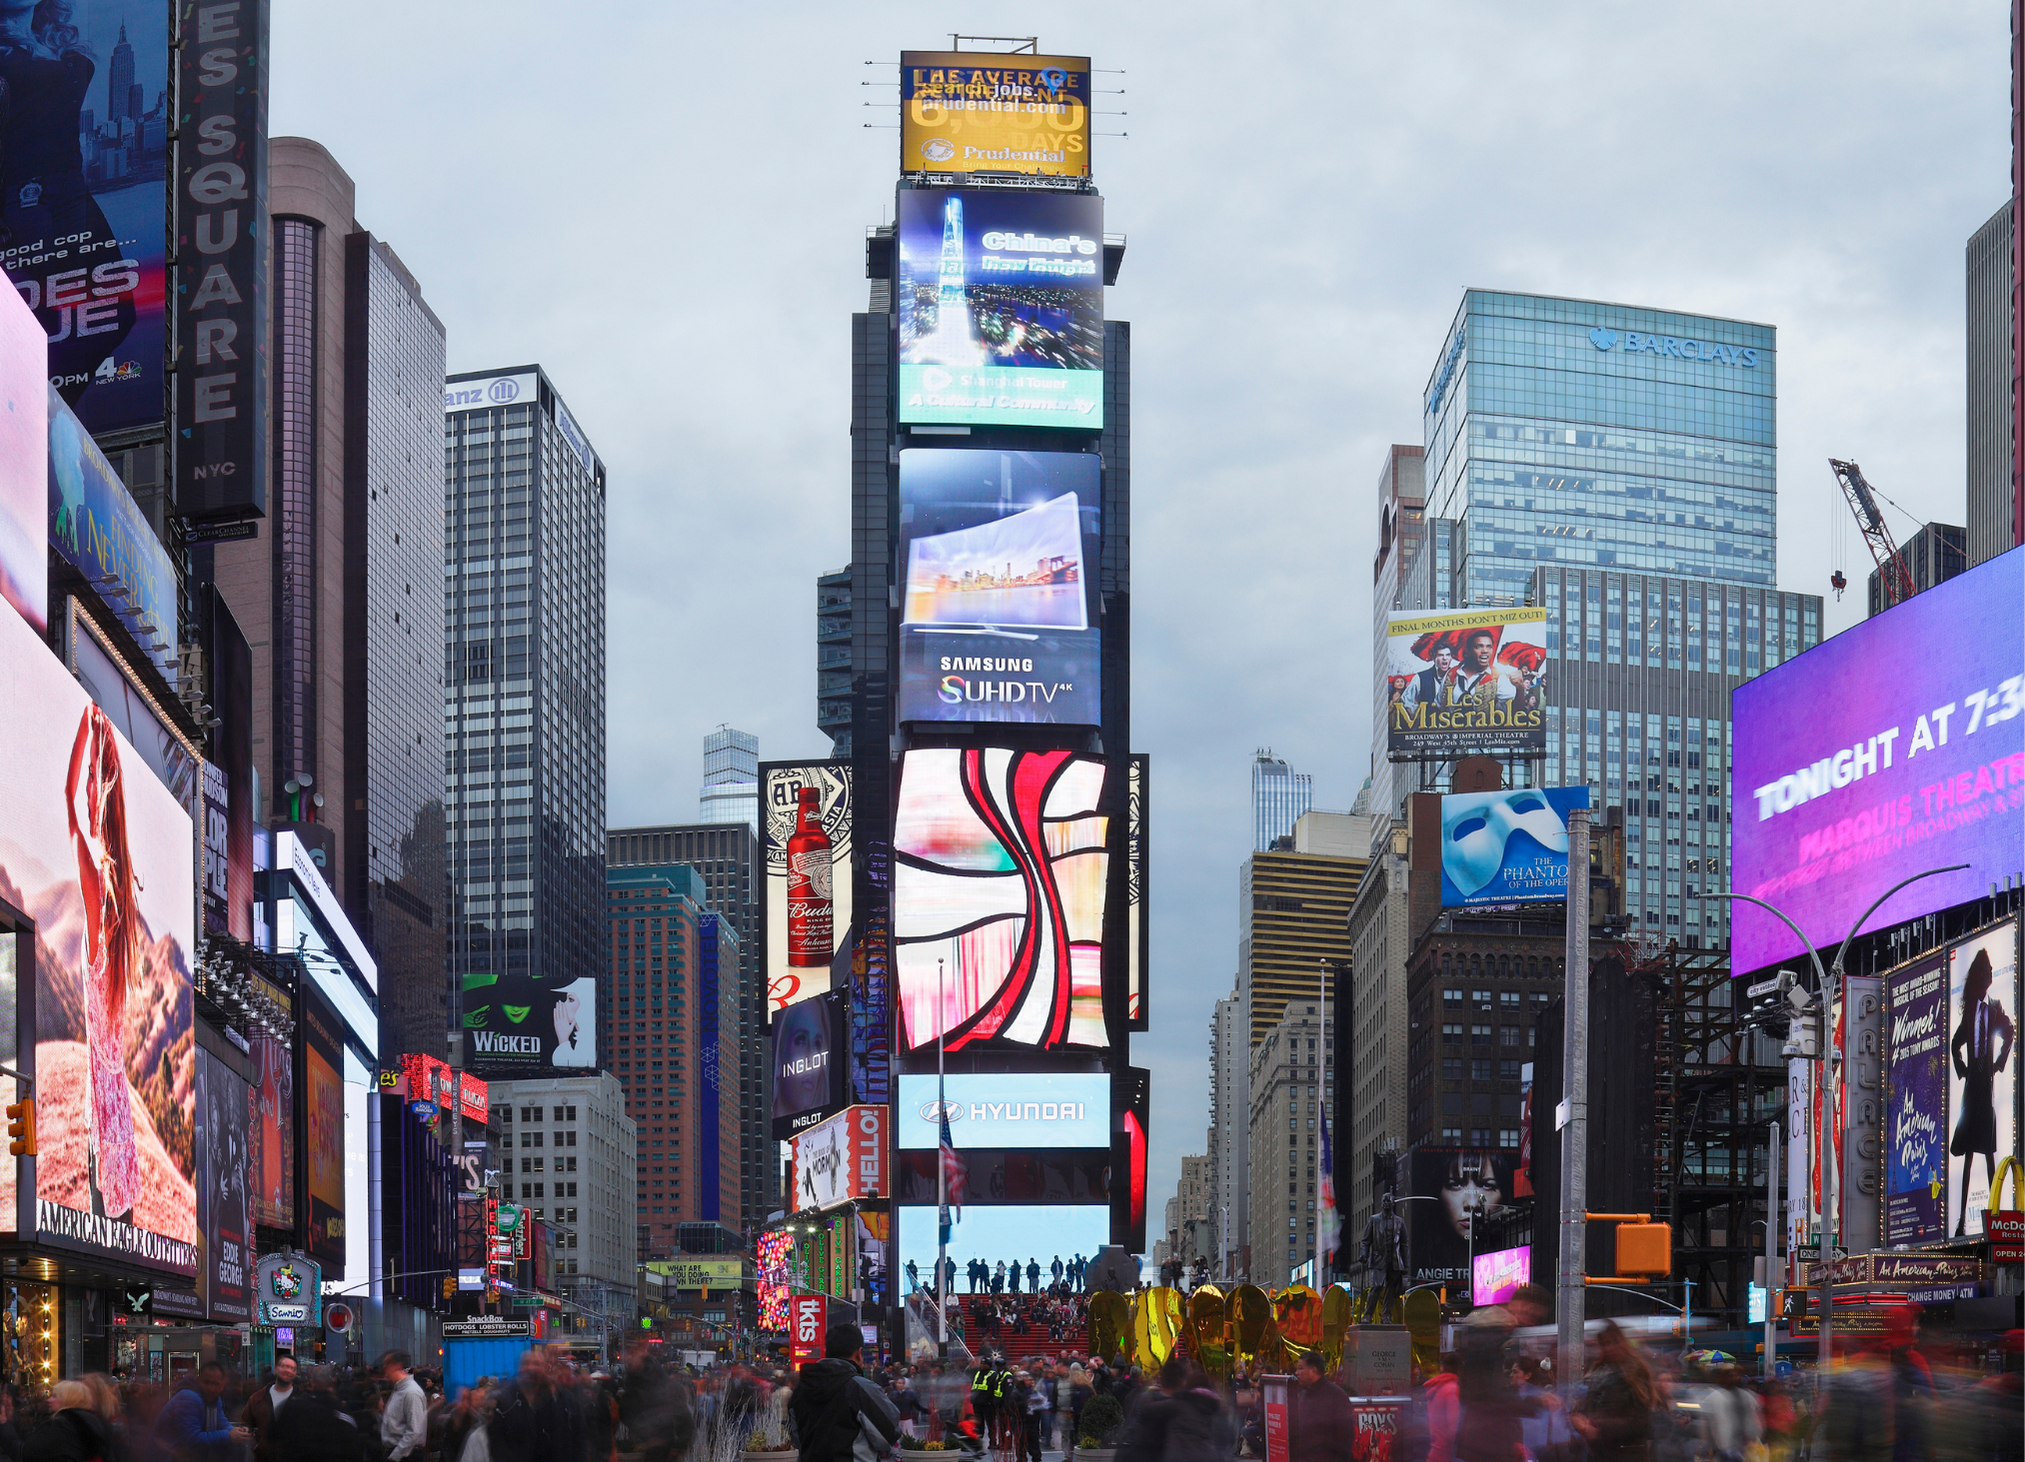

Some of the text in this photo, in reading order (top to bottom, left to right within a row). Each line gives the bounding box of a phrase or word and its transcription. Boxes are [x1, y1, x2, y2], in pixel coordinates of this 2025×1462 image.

[923, 81, 1038, 98] search jobs.
[922, 98, 1066, 115] prudential.com
[1014, 132, 1083, 153] DAYS
[963, 146, 1066, 163] Prudential
[962, 162, 989, 171] Bring
[991, 162, 1014, 171] Your
[0, 231, 92, 263] good cop
[982, 231, 1098, 256] China's
[5, 238, 137, 271] there are...
[188, 114, 248, 425] SQUARE
[1624, 331, 1758, 368] BARCLAYS
[96, 356, 117, 378] 4
[96, 373, 142, 386] NEW YORK
[1026, 376, 1069, 390] Tower
[907, 394, 1096, 415] A Cultural Community
[194, 462, 236, 481] NYC
[112, 514, 159, 605] FINDING
[1392, 623, 1420, 633] FINAL
[1467, 615, 1498, 626] DON'T
[1500, 612, 1518, 622] MIZ
[1518, 610, 1543, 621] OUT!
[940, 656, 1034, 673] SAMSUNG
[1059, 683, 1073, 691] 4K
[1446, 685, 1483, 708] Les
[1393, 698, 1542, 730] Misérables
[1404, 731, 1529, 741] BROADWAY'S IMPERIAL THEATRE
[1427, 738, 1442, 746] West
[1459, 737, 1477, 746] Street
[1753, 725, 1899, 822] TONIGHT
[1907, 702, 1956, 760] AT
[1534, 857, 1553, 866] THE
[1509, 878, 1544, 889] OF THE
[701, 927, 718, 1033] NOVOTEL
[1760, 982, 1776, 991] outdoo
[1899, 981, 1910, 995] MOST
[1893, 992, 1910, 1008] MUSICAL
[1891, 998, 1941, 1046] Winner!
[1892, 1035, 1940, 1068] 4 2015 TONY AWARDS
[782, 1051, 829, 1078] INGLOT
[1857, 993, 1877, 1194] PALACE
[1903, 1087, 1915, 1119] An
[792, 1112, 822, 1129] INGLOT
[970, 1102, 1085, 1121] HYUNDAI
[1895, 1111, 1937, 1150] American
[860, 1110, 880, 1194] HELLO!
[1901, 1137, 1928, 1170] Paris
[39, 1200, 198, 1270] AMERICAN EAGLE OUTFITTERS
[1991, 1220, 2025, 1231] McDo
[223, 1240, 239, 1265] EDDIE
[817, 1231, 825, 1264] OLIVE
[834, 1219, 843, 1296] OLIVE GARDEN
[1802, 1250, 1842, 1259] ONE AY
[1995, 1250, 2017, 1258] OPEN
[219, 1260, 243, 1287] GEORGE
[672, 1271, 687, 1279] YOU
[1416, 1268, 1453, 1280] ANGIE
[1878, 1261, 1891, 1277] An
[1892, 1259, 1934, 1280] American
[1936, 1261, 1959, 1280] Paris
[1907, 1287, 1974, 1302] CHANGE MONEY ATM
[271, 1305, 304, 1319] Sanrio
[466, 1314, 504, 1324] SnackBox
[798, 1299, 821, 1343] tkts
[444, 1323, 528, 1333] HOTDOGS LOBSTER ROLLS
[1371, 1350, 1397, 1358] GEORGE
